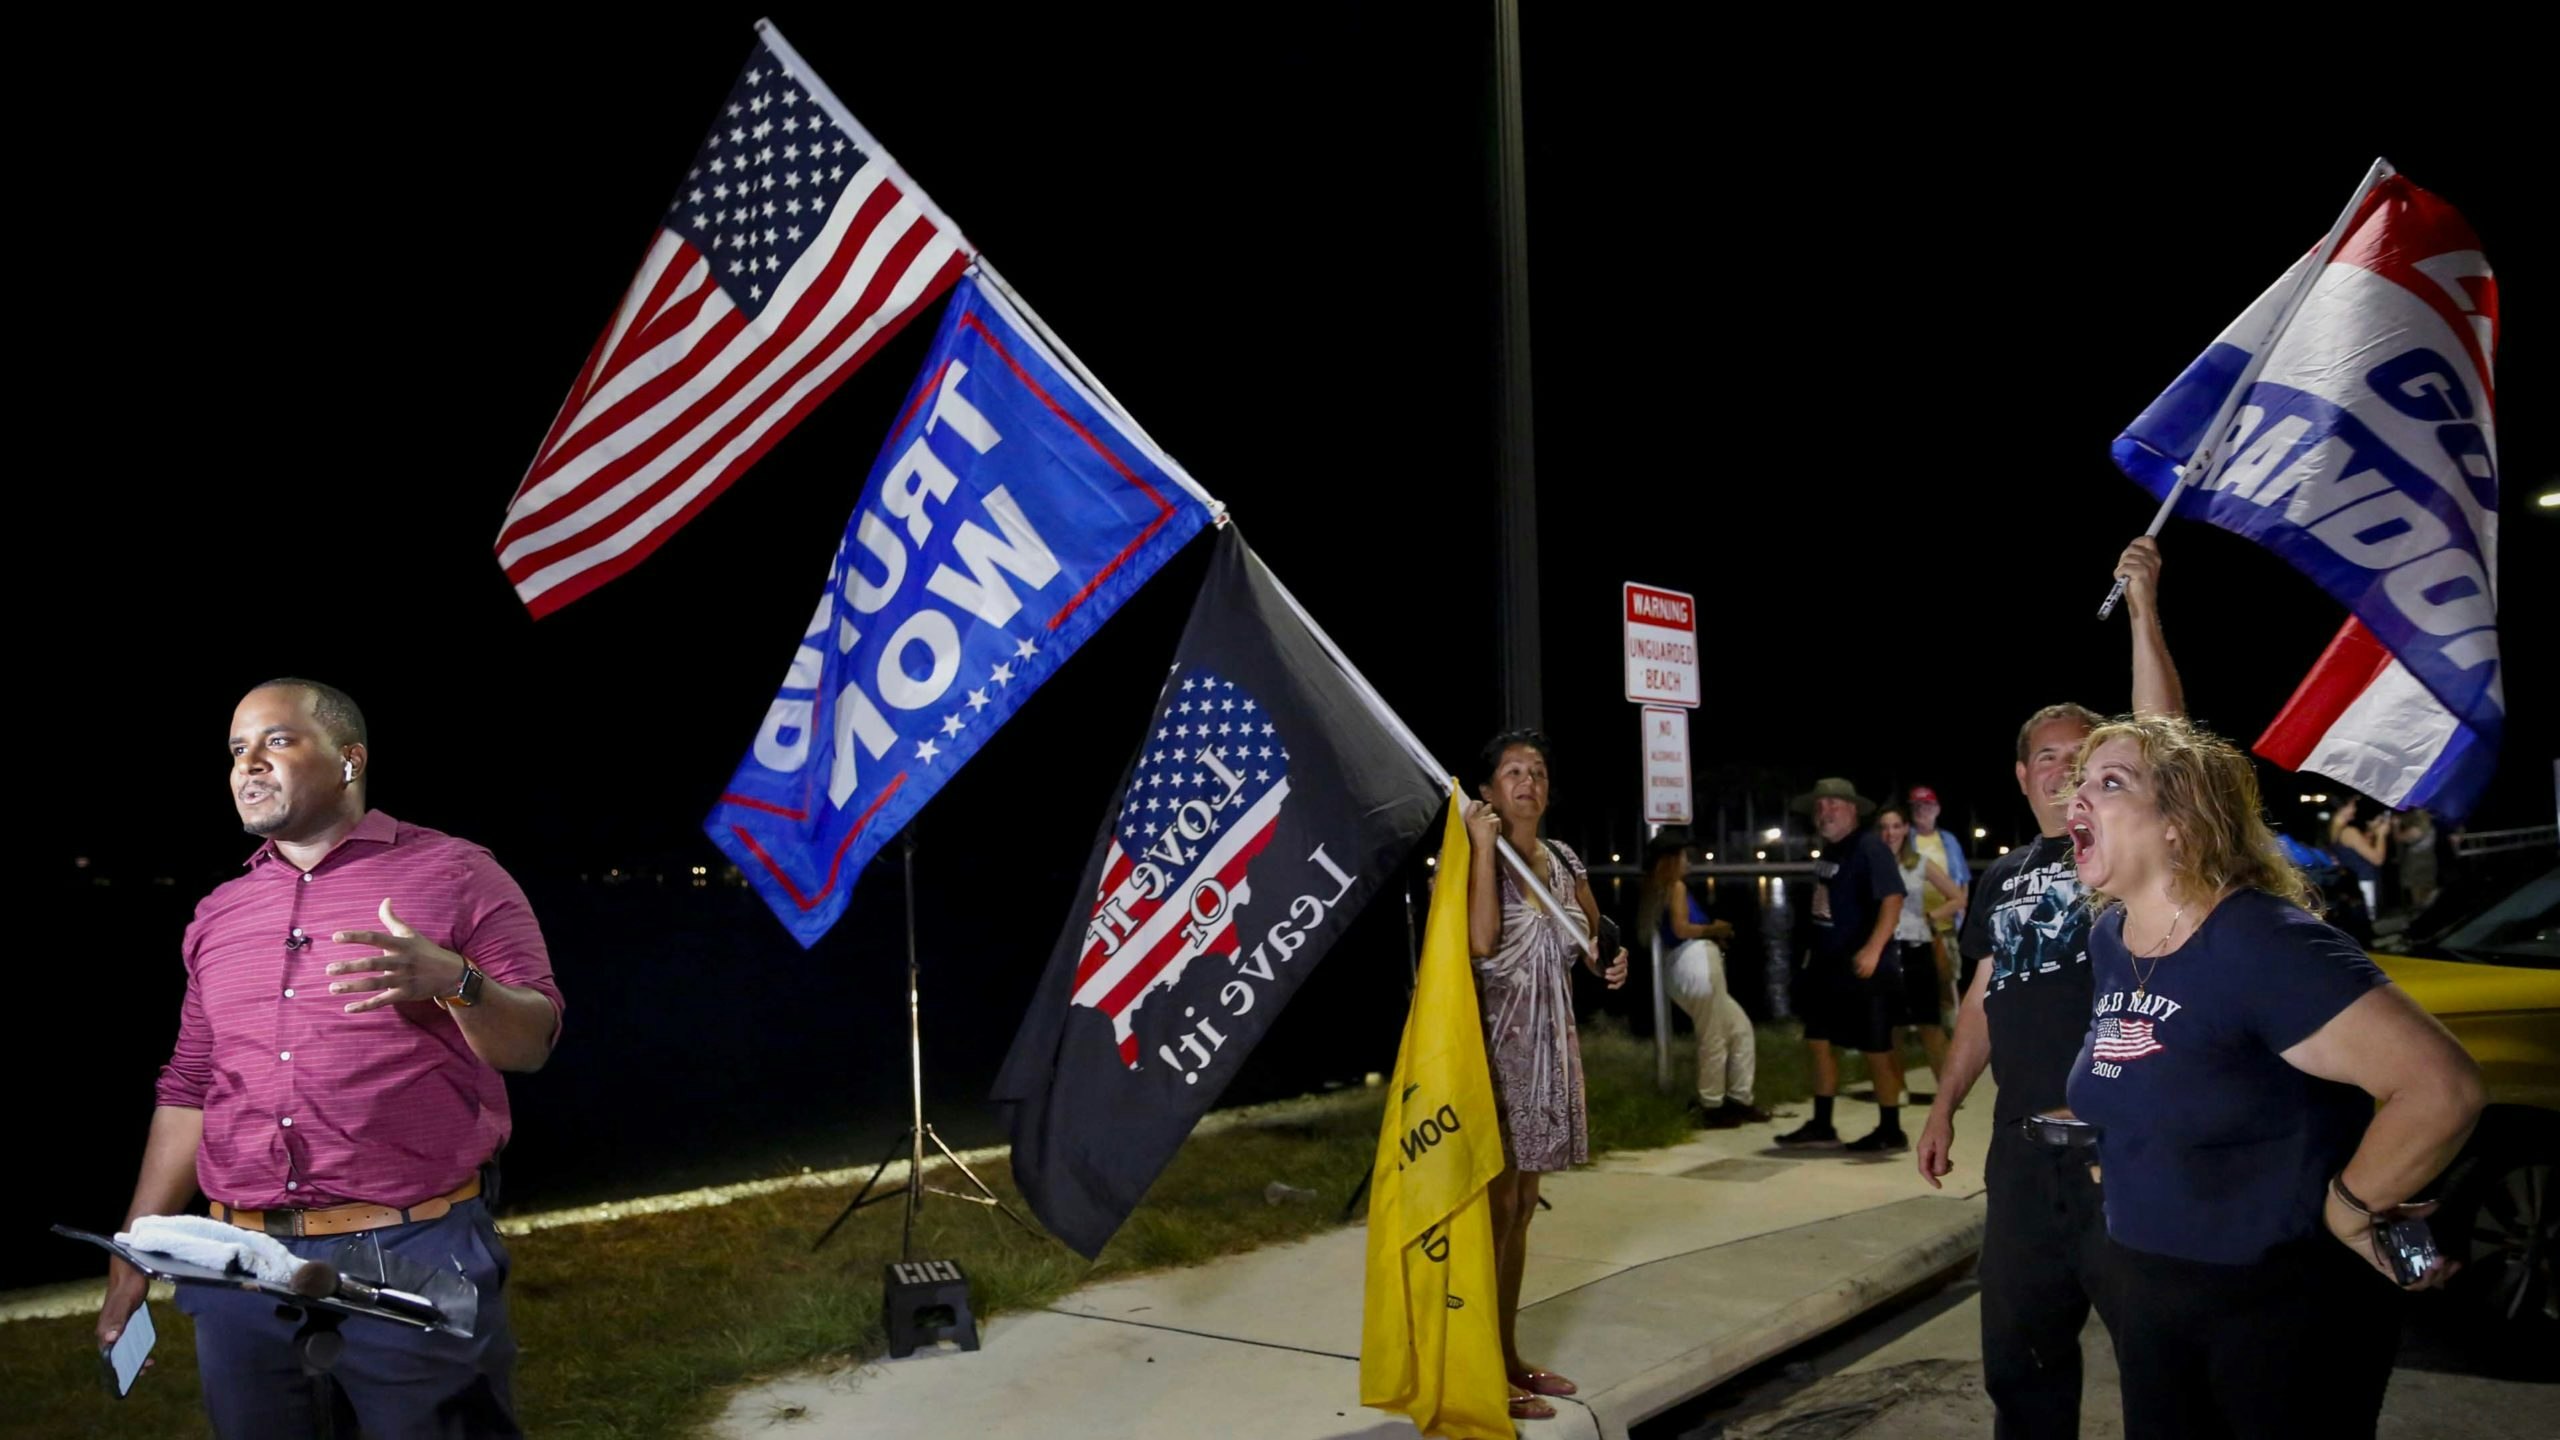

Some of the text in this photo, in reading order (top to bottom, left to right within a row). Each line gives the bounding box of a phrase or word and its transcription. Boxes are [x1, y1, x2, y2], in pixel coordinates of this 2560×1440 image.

[2174, 404, 2498, 671] RANDO
[1632, 592, 1689, 624] WARNING
[1629, 638, 1694, 666] UNGUARDED
[1646, 668, 1682, 692] BEACH
[2095, 991, 2182, 1022] OLD NAVY
[2091, 1060, 2122, 1079] 2010
